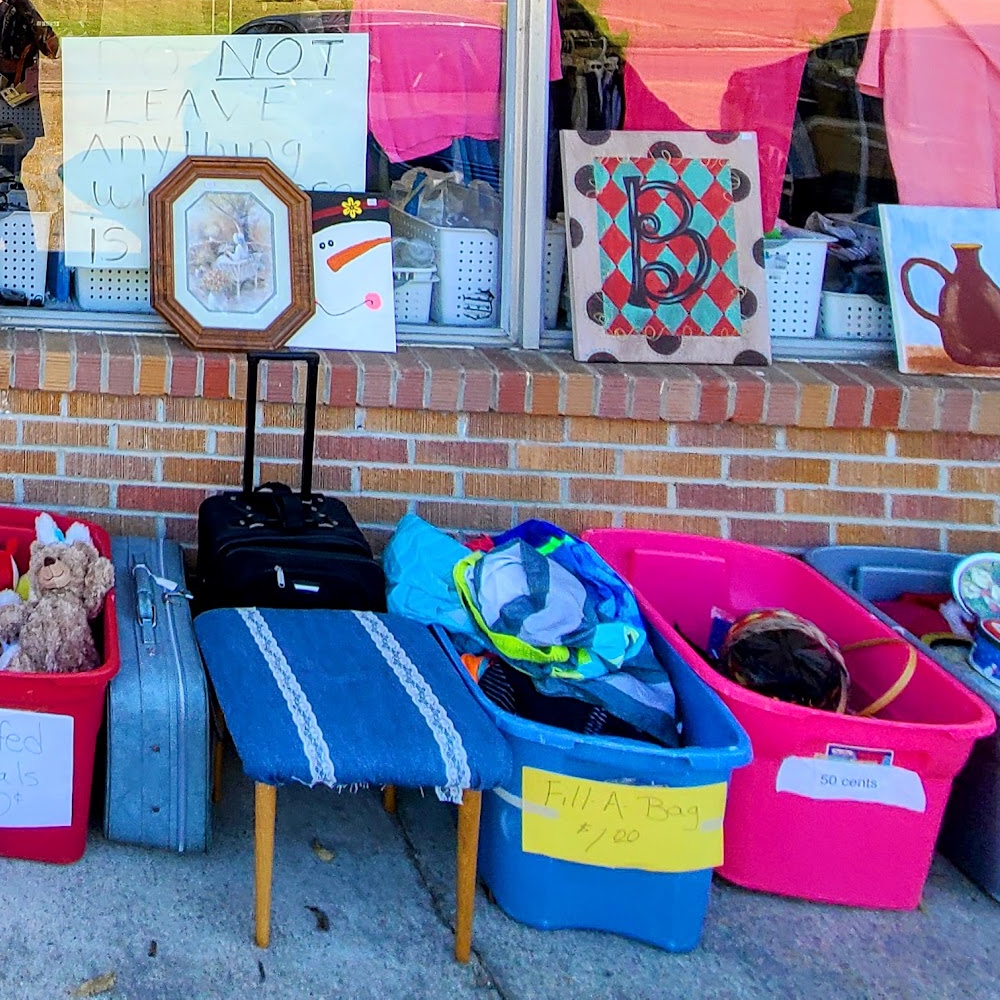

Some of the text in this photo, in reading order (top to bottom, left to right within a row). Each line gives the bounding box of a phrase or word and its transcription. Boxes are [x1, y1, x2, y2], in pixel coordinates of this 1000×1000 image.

[217, 36, 344, 78] NOT
[104, 84, 286, 124] LEAVE
[88, 216, 129, 264] is
[819, 773, 878, 789] 50 cents
